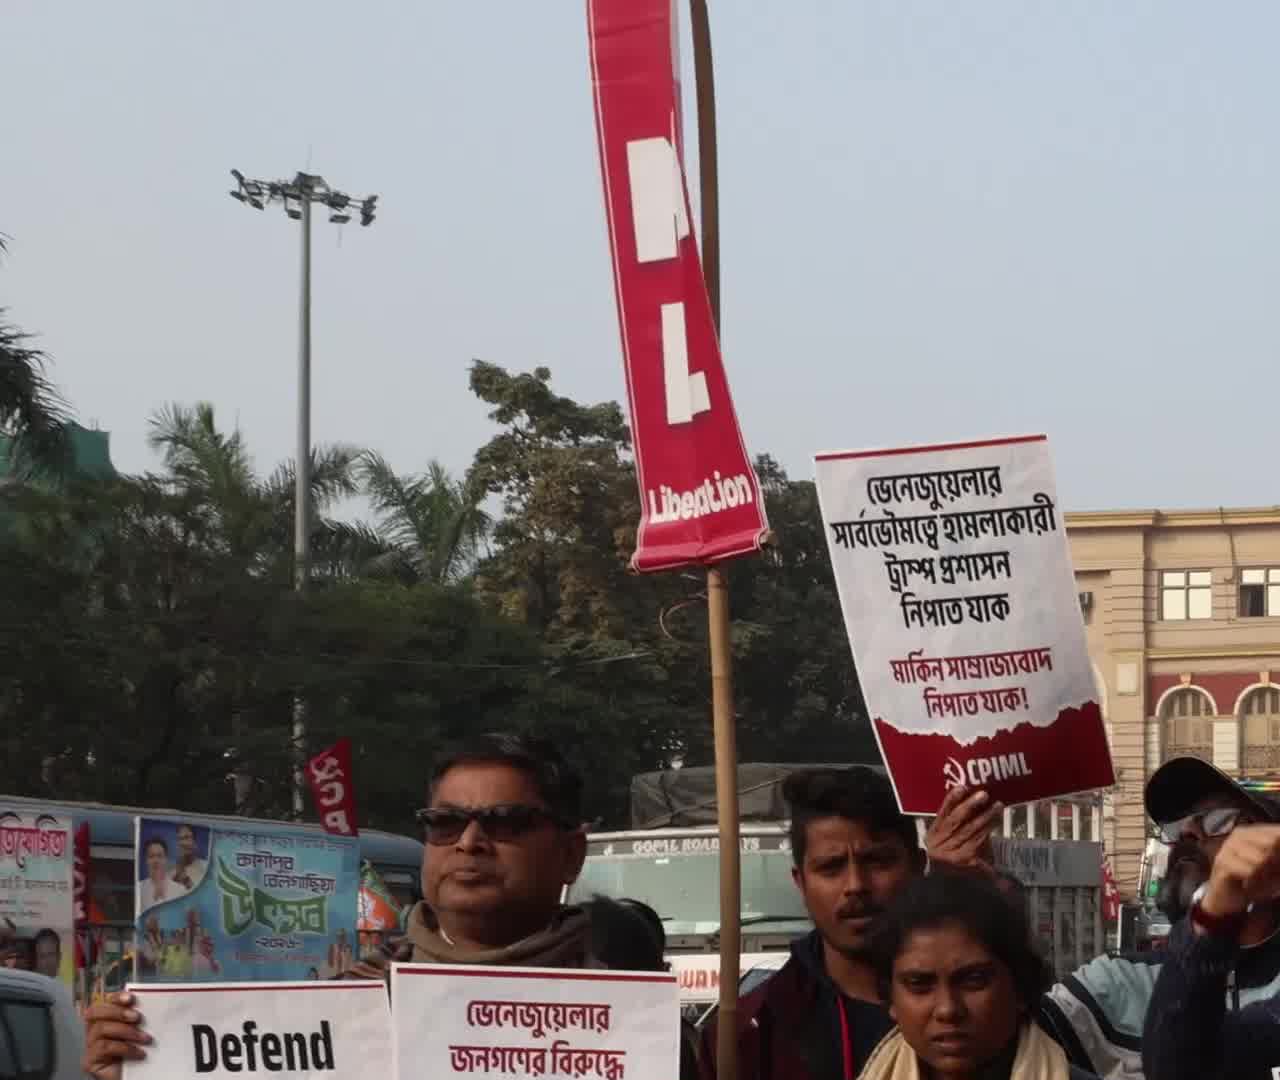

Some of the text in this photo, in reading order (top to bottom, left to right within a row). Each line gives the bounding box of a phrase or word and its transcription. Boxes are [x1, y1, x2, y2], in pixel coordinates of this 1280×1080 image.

[867, 466, 1002, 509] ভেনেজুয়েলার
[830, 493, 1056, 551] সার্বভৌমত্বে হামলাকারী
[885, 551, 1011, 593] ট্রাম্প প্রশাসন
[900, 592, 1010, 629] নিপাত যাক
[889, 647, 1053, 684] মার্কিন সাম্রাজ্যবাদ
[923, 687, 1029, 719] নিপাত যাক!
[967, 753, 1033, 787] CPIML
[682, 837, 760, 853] ROADYS
[467, 999, 611, 1040] ভেনেজুয়েলার
[192, 1020, 335, 1073] Defend
[449, 1045, 548, 1077] জনগণের
